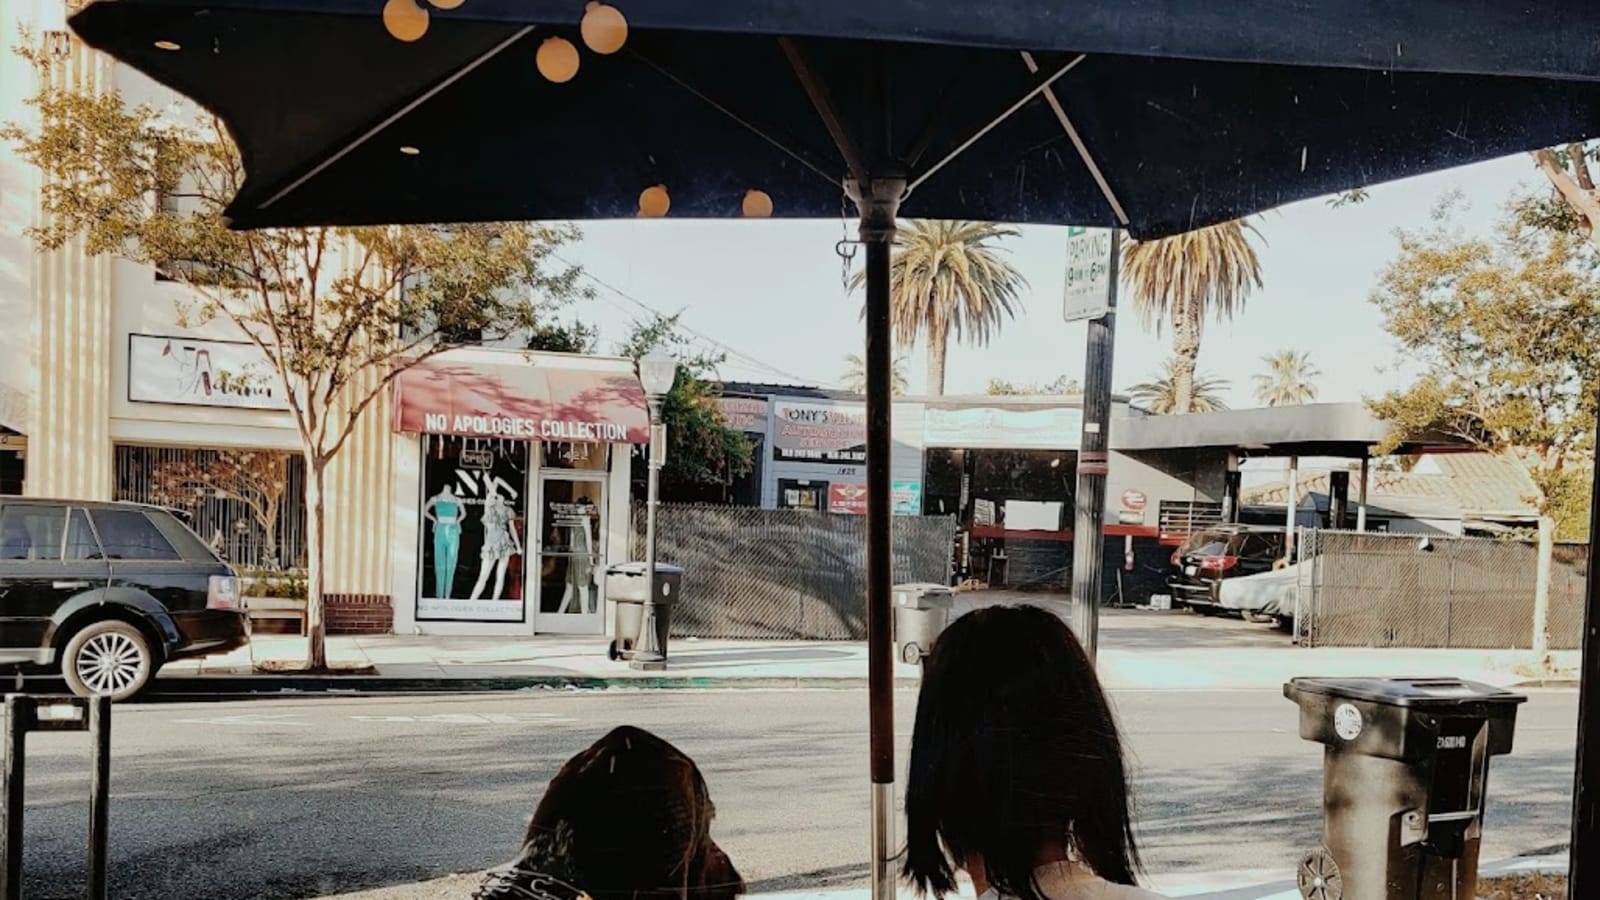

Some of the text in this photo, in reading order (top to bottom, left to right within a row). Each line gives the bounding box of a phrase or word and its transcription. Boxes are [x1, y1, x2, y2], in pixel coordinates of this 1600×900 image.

[1068, 232, 1107, 262] PARKING
[781, 407, 828, 423] TONY'S
[426, 413, 627, 439] NO APOLOGIES COLLECTION
[463, 453, 490, 465] OPEN
